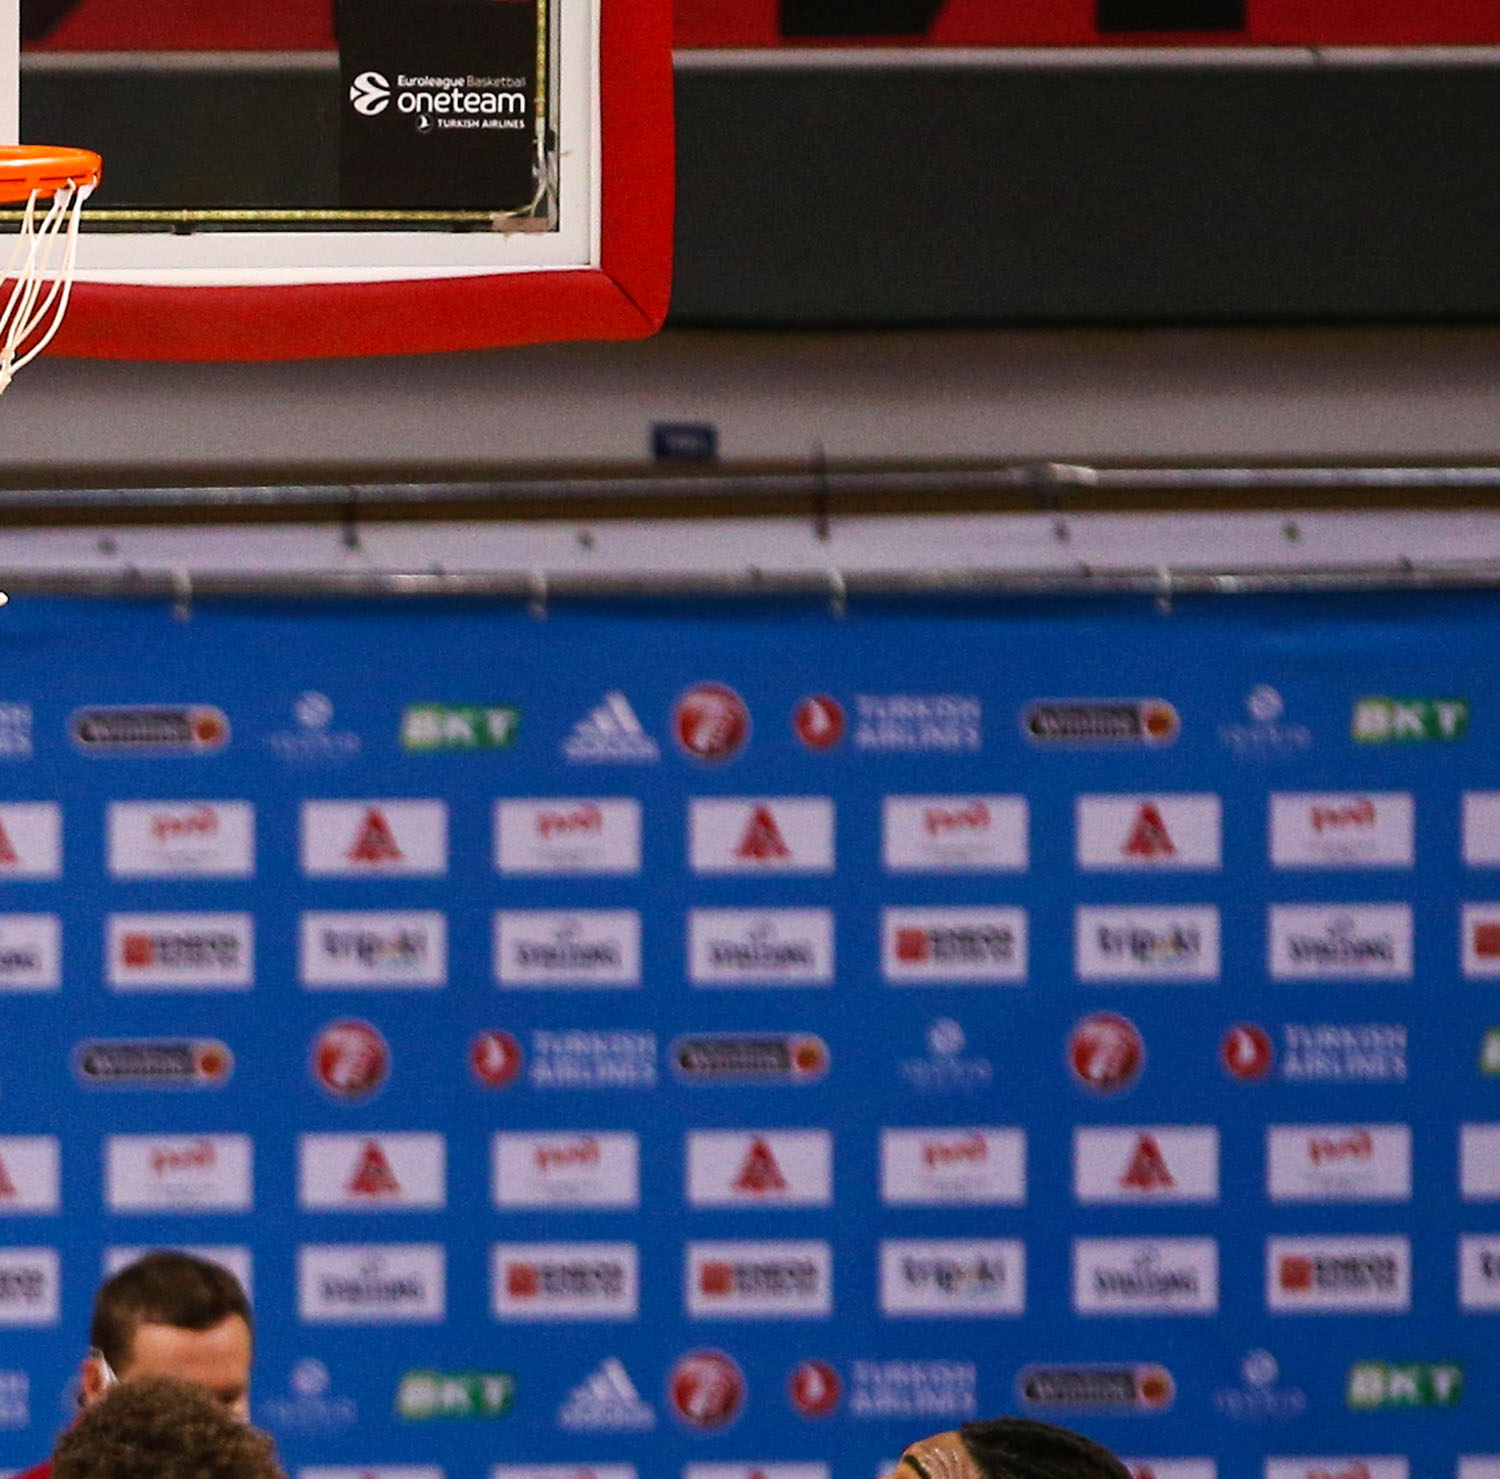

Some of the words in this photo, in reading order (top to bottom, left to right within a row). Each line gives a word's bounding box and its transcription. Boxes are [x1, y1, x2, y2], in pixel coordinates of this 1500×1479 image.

[397, 75, 465, 90] Euroleague
[466, 75, 527, 88] Basketball
[397, 88, 526, 113] oneteam
[437, 118, 480, 129] TURKISH
[481, 118, 526, 129] AIRLINES
